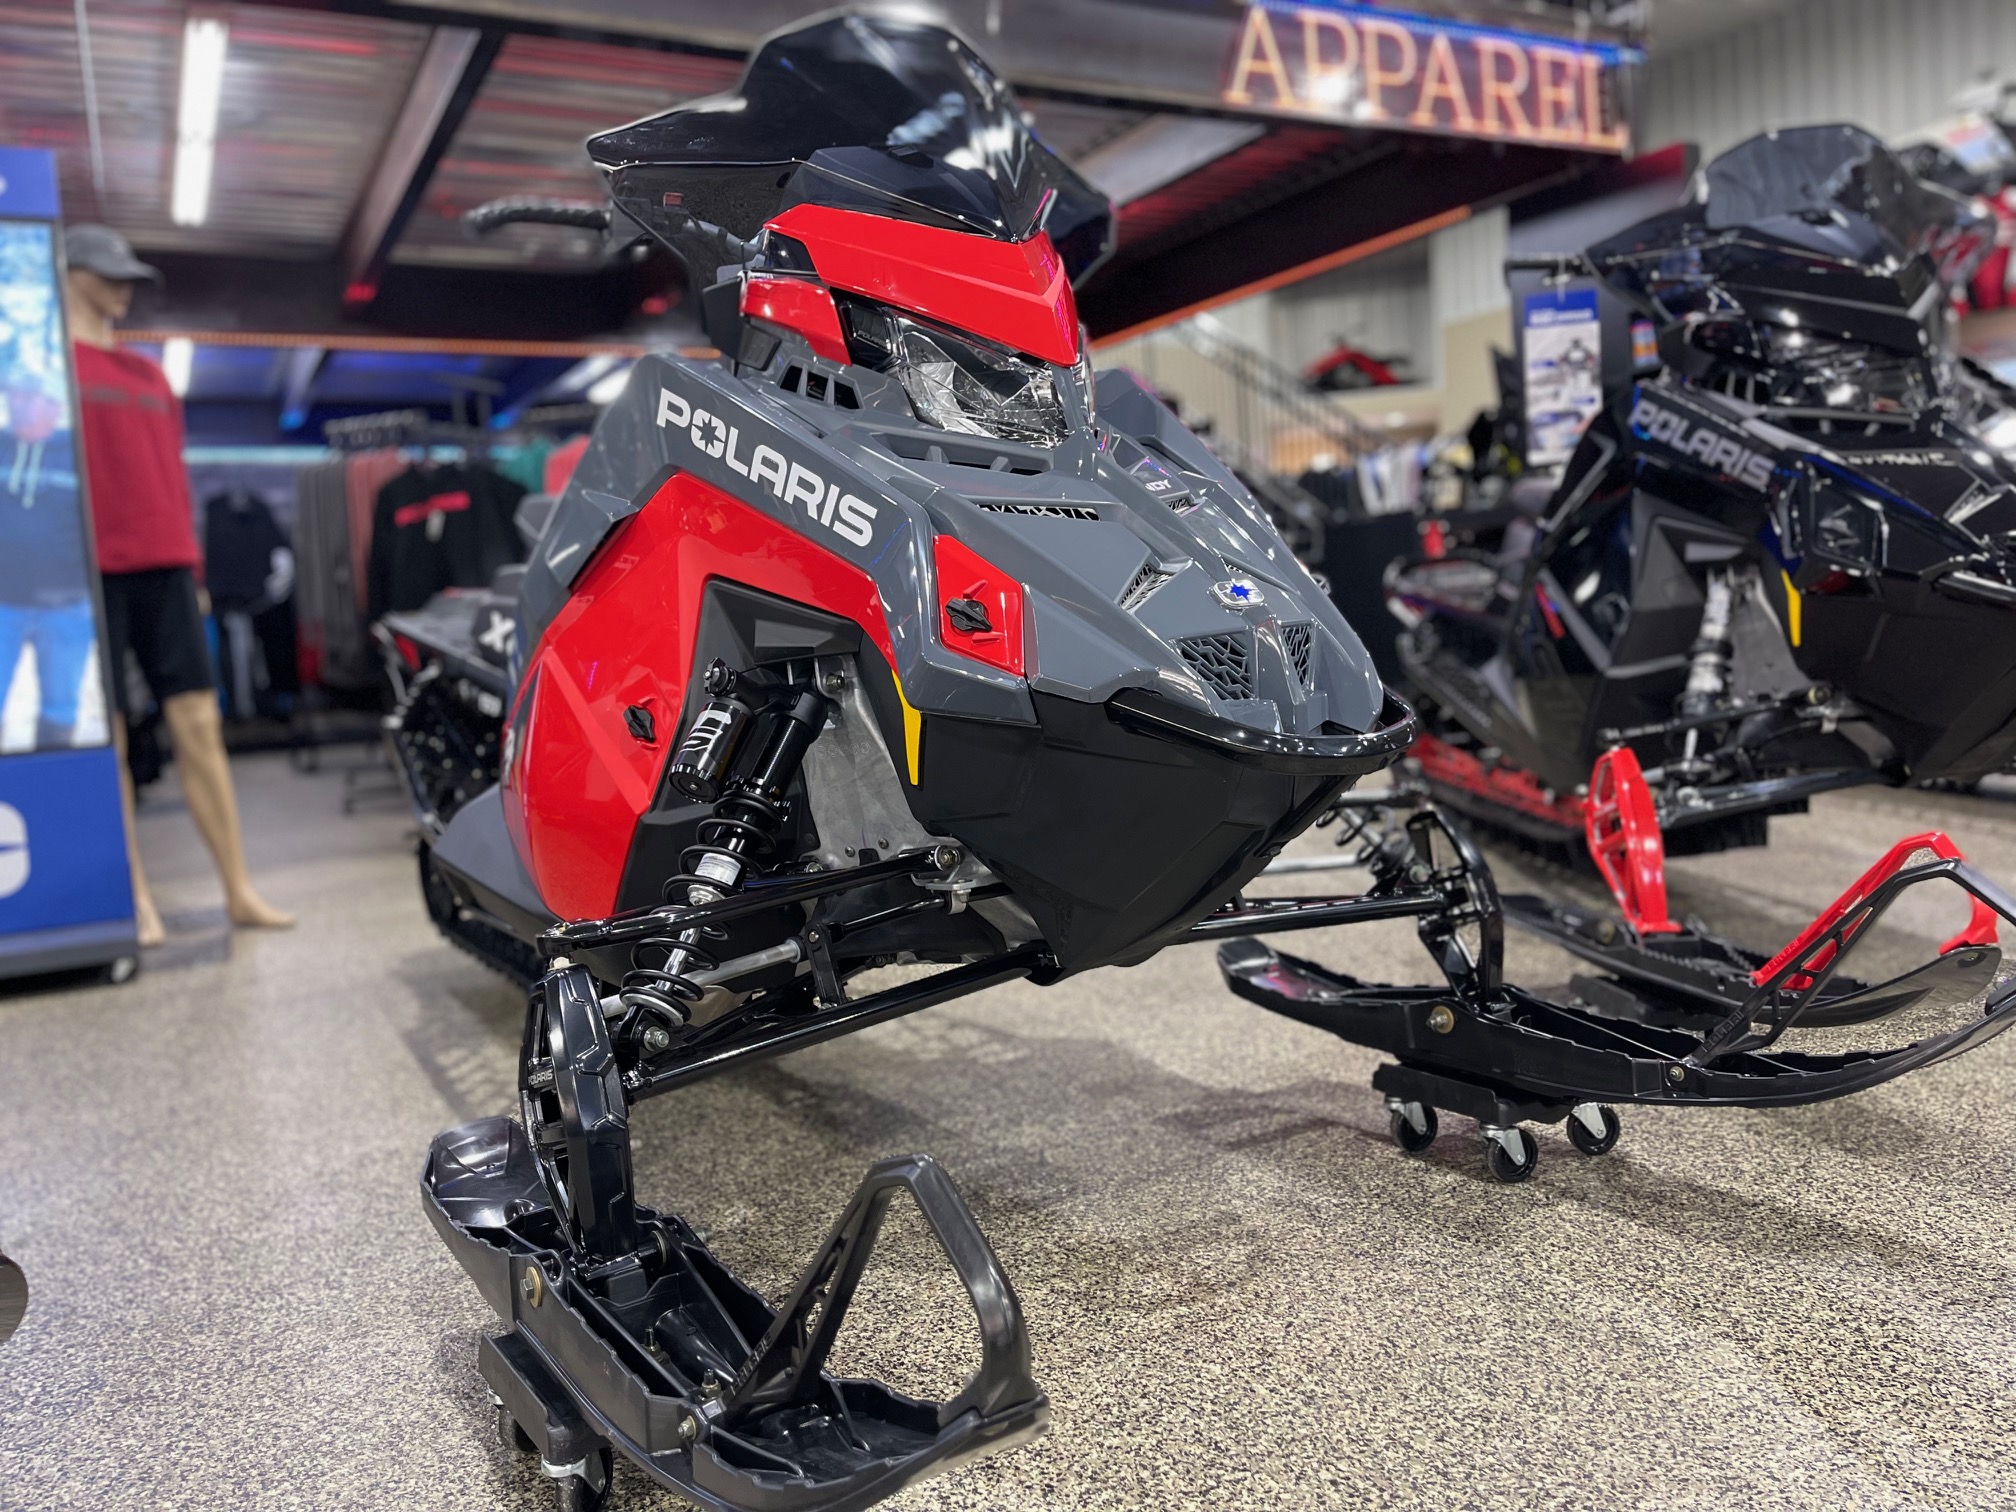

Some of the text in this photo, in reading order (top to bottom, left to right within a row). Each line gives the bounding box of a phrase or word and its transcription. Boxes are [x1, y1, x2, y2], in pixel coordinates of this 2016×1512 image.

[1223, 6, 1629, 149] APPAREL
[656, 387, 878, 547] POLARIS
[1627, 398, 1777, 492] POLARIS
